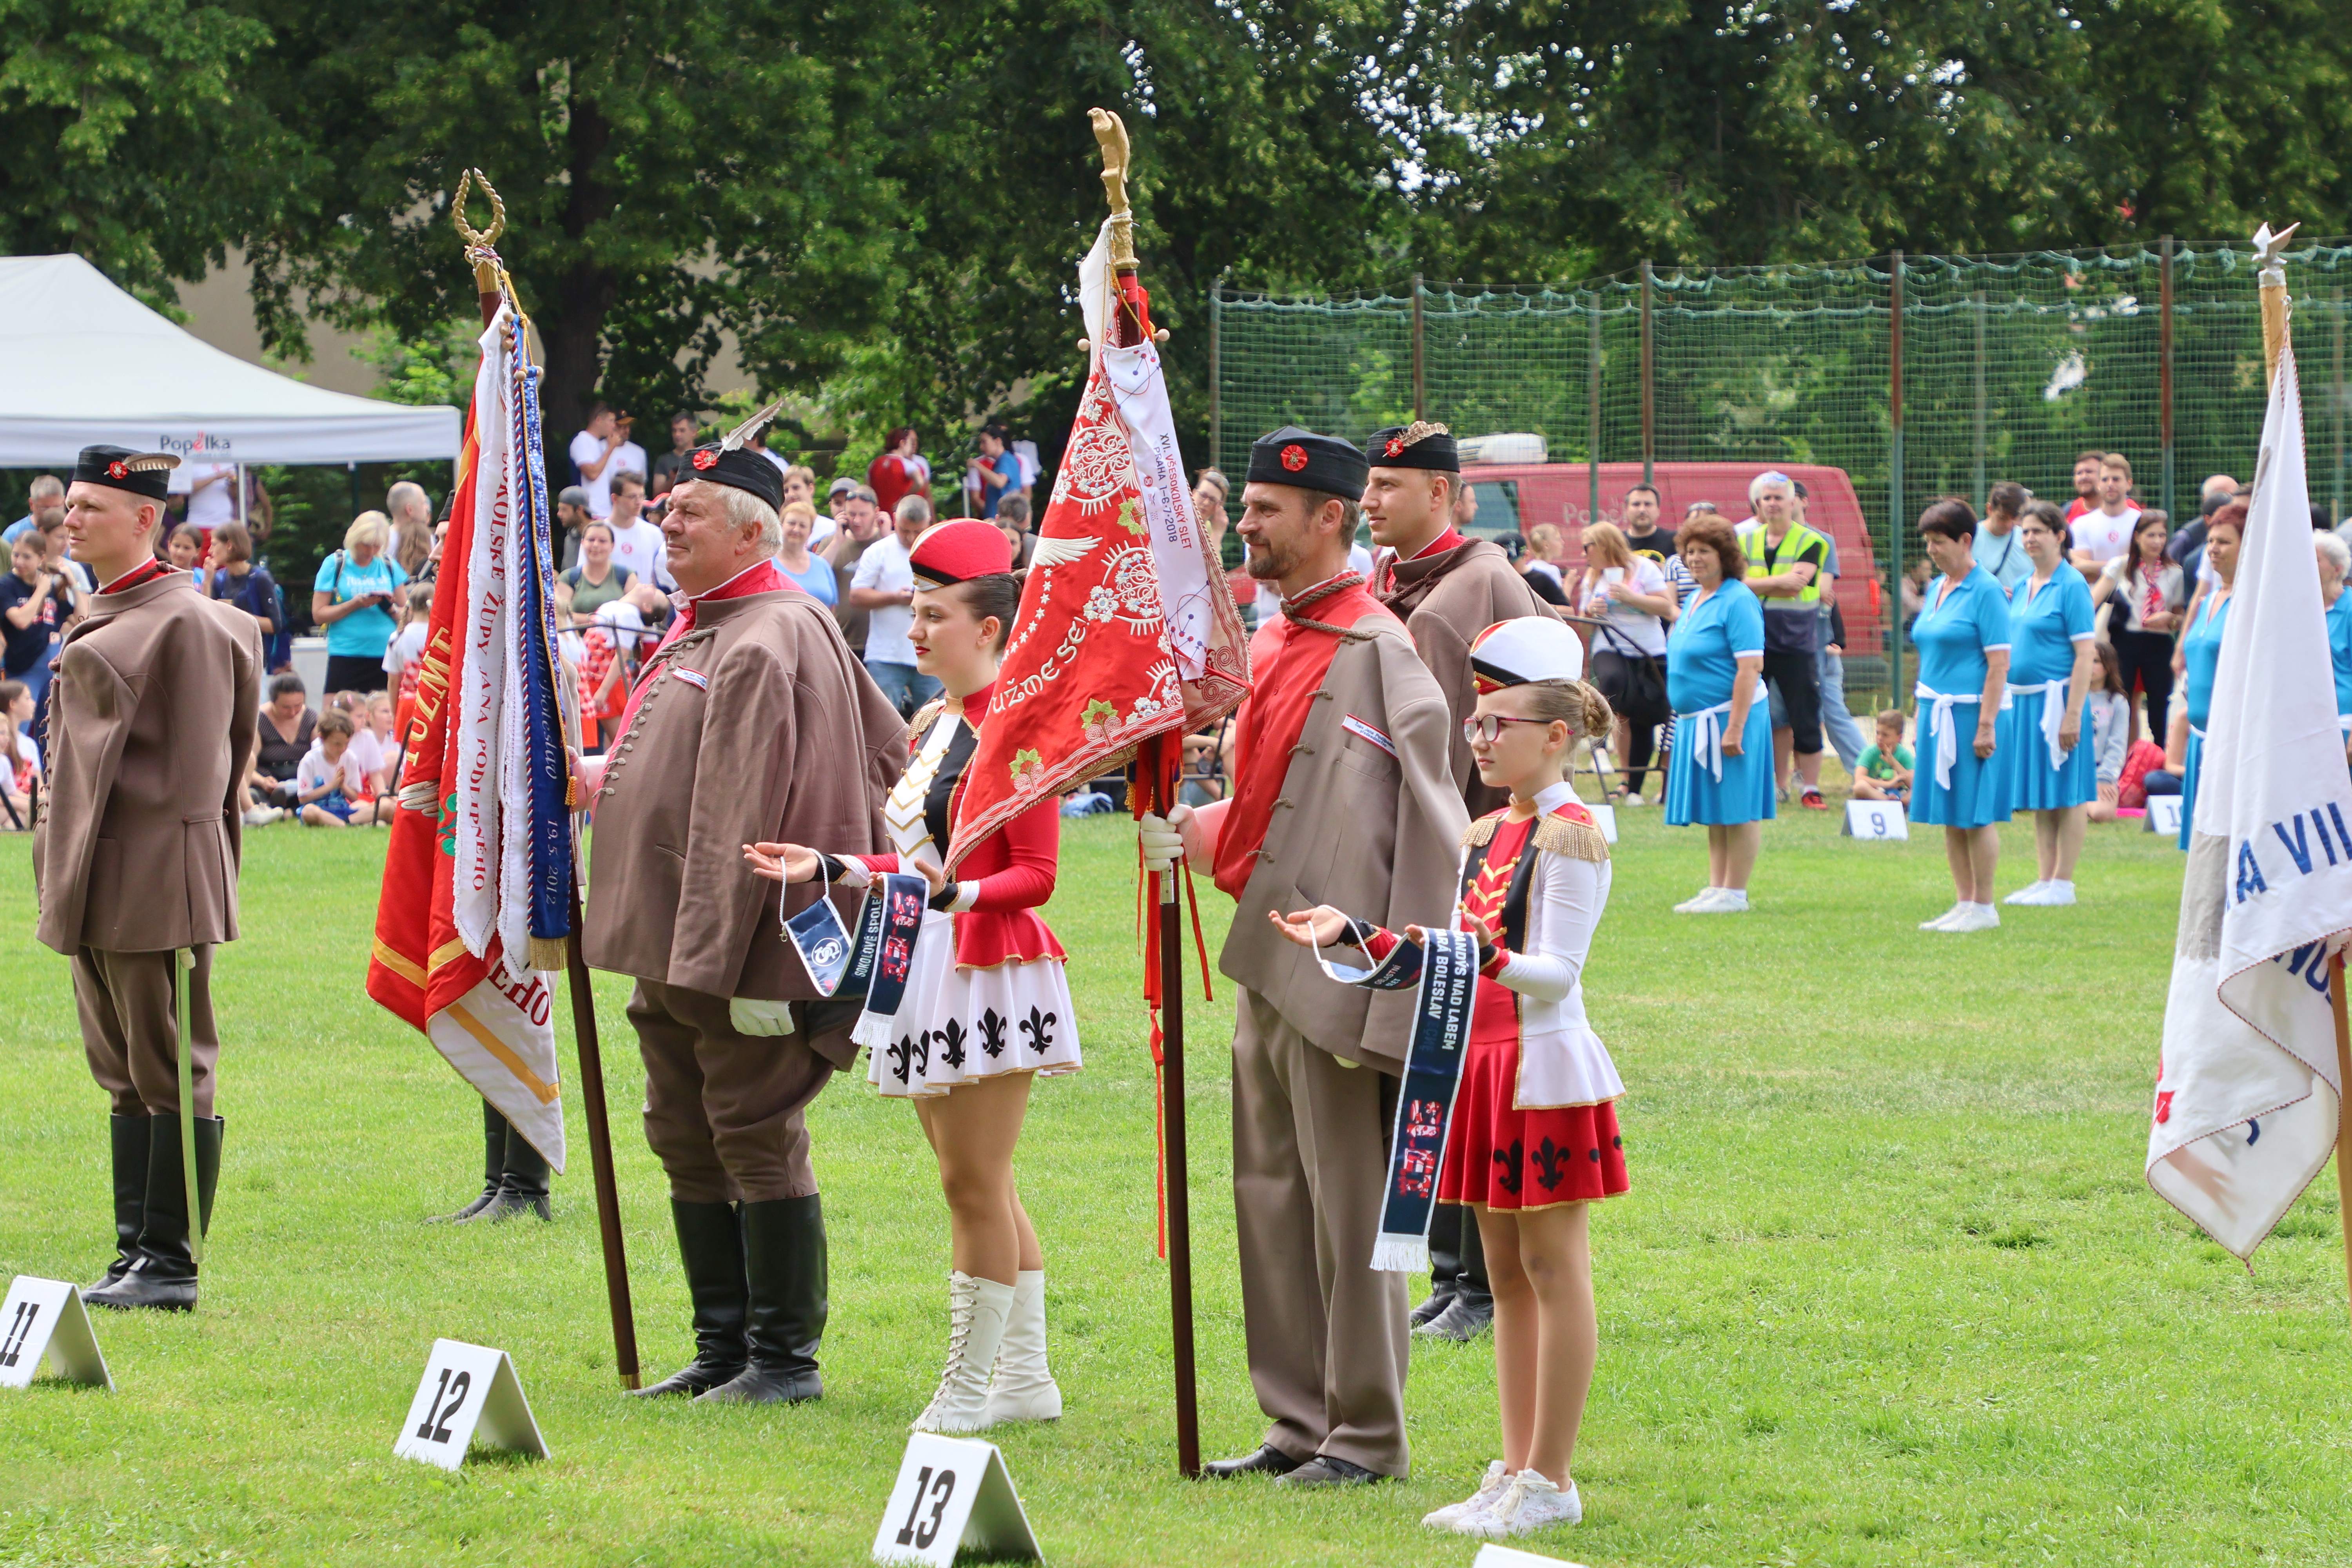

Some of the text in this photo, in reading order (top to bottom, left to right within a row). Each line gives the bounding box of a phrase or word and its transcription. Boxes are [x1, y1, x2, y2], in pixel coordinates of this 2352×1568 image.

[160, 434, 230, 455] Popelka
[1154, 447, 1167, 481] PRAHA
[1159, 433, 1191, 549] XVI. VŠESOKOLSKÝ SLET
[477, 591, 505, 656] ŽUPY
[476, 665, 492, 724] JANA
[469, 737, 487, 891] PODLIPNÉHO
[1871, 811, 1887, 835] 9
[546, 818, 558, 904] 19. 5. 2012
[854, 896, 882, 978] SOKOLOVÉ SPOLE
[1374, 964, 1402, 985] OBLASTNÍ
[1428, 955, 1448, 1020] BOLESLAV
[1450, 979, 1466, 1006] NAD
[1442, 1008, 1461, 1051] LABEM
[0, 1301, 40, 1367] 11
[416, 1368, 471, 1444] 12
[895, 1466, 956, 1550] 13
